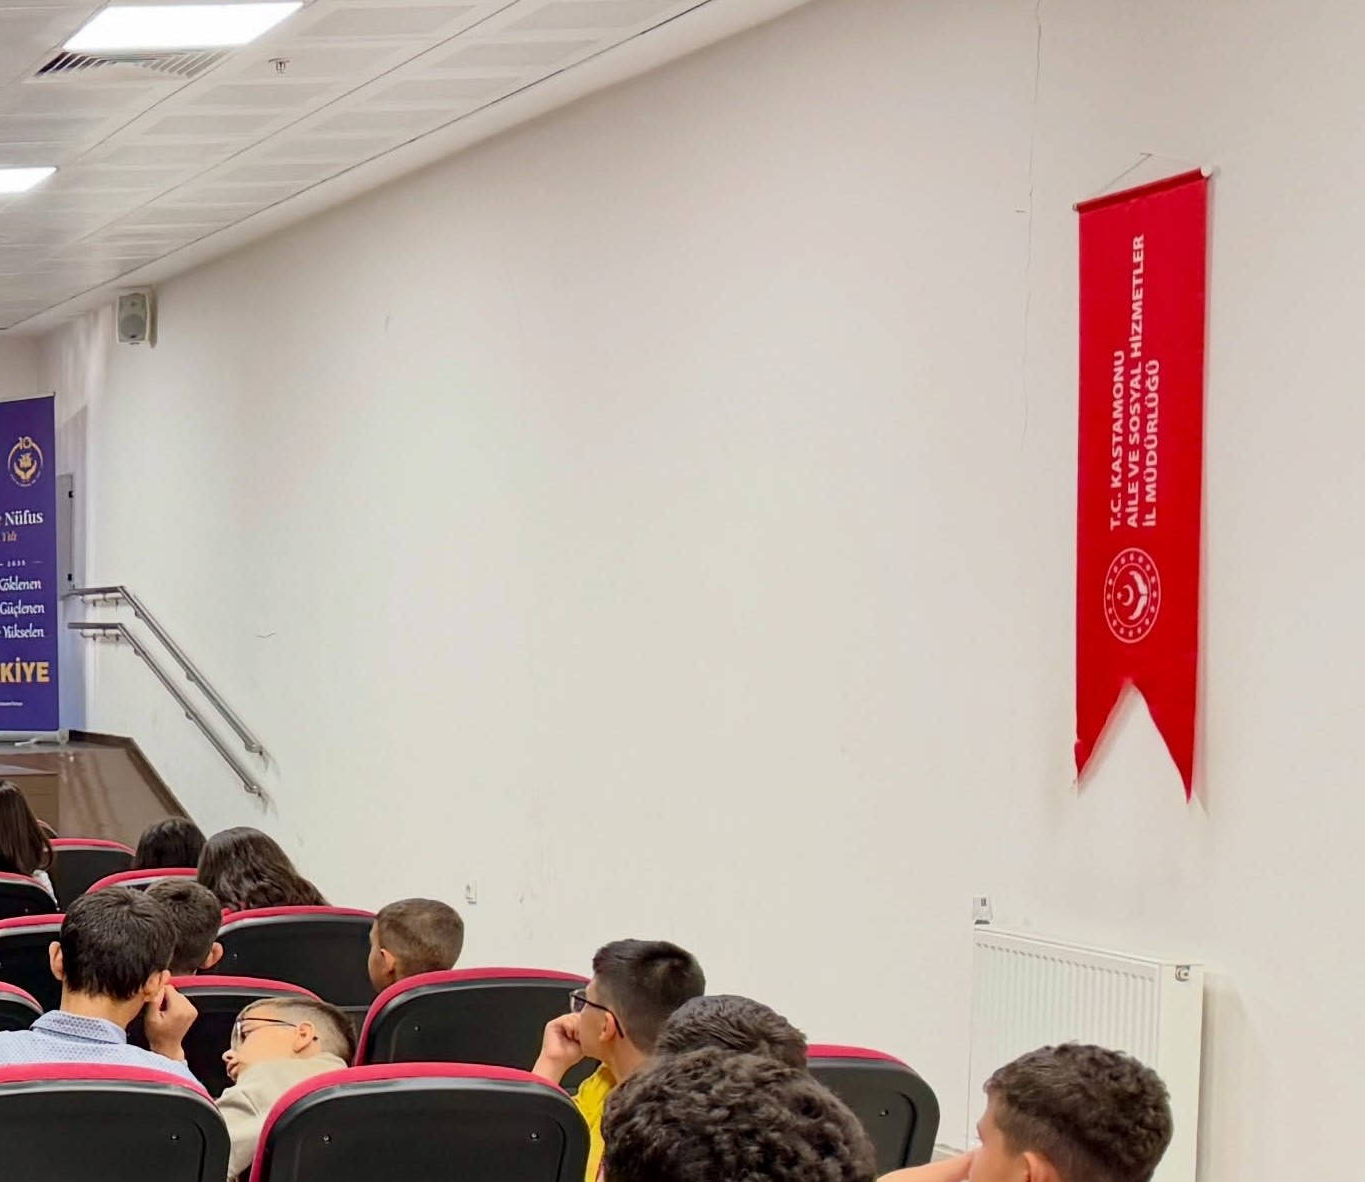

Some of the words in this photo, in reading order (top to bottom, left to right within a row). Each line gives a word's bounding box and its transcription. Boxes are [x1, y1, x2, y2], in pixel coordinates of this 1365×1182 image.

[1129, 233, 1144, 358] HİZMETLER
[1111, 350, 1125, 488] KASTAMONU
[1129, 362, 1142, 445] SOSYAL
[1143, 359, 1160, 502] MÜDÜRLÜĞÜ
[1128, 449, 1140, 478] VE
[4, 510, 44, 526] Nüfus
[1110, 493, 1122, 531] T.C.
[1125, 480, 1139, 528] AİLE
[1142, 507, 1157, 527] İL
[0, 599, 45, 618] Güçlenen
[2, 623, 45, 638] Yükselen
